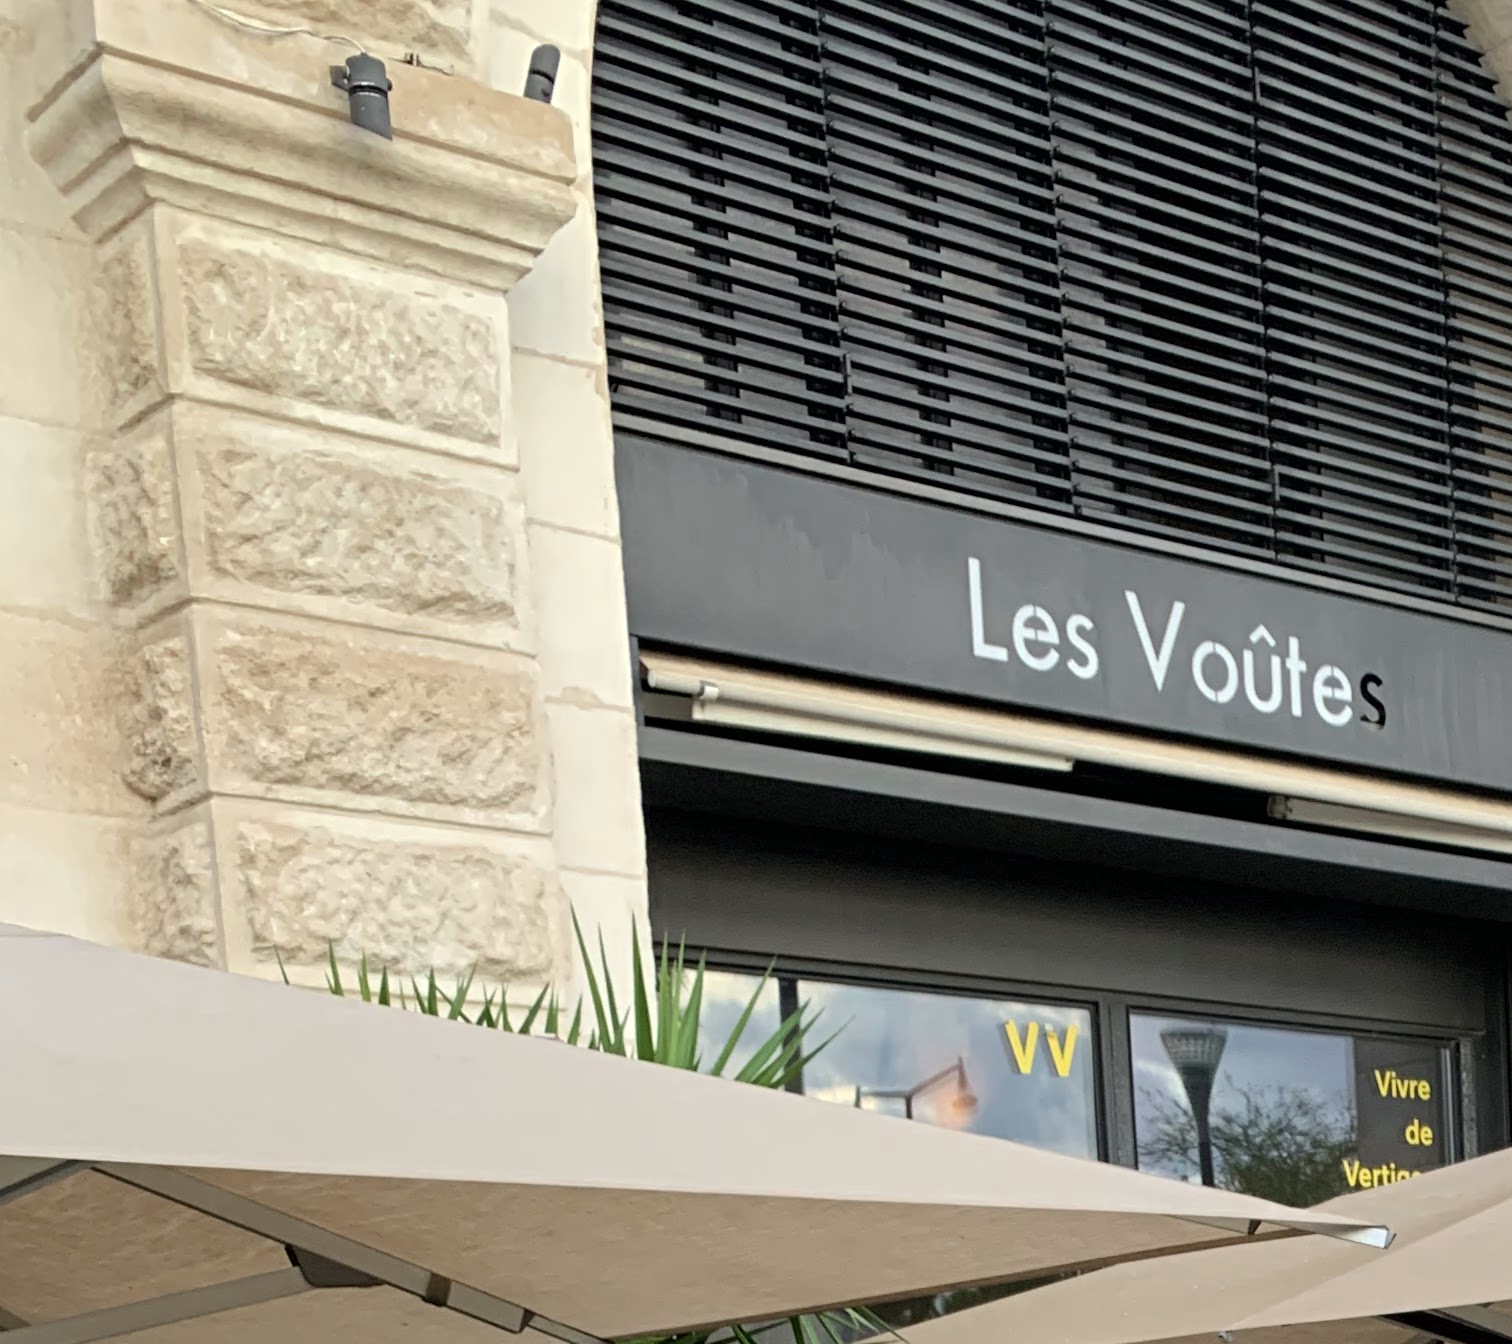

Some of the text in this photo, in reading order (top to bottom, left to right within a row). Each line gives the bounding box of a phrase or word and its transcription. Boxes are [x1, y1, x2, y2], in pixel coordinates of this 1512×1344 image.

[968, 557, 1387, 731] Les Voûtes
[1374, 1069, 1431, 1100] Vivre
[1405, 1118, 1433, 1146] de
